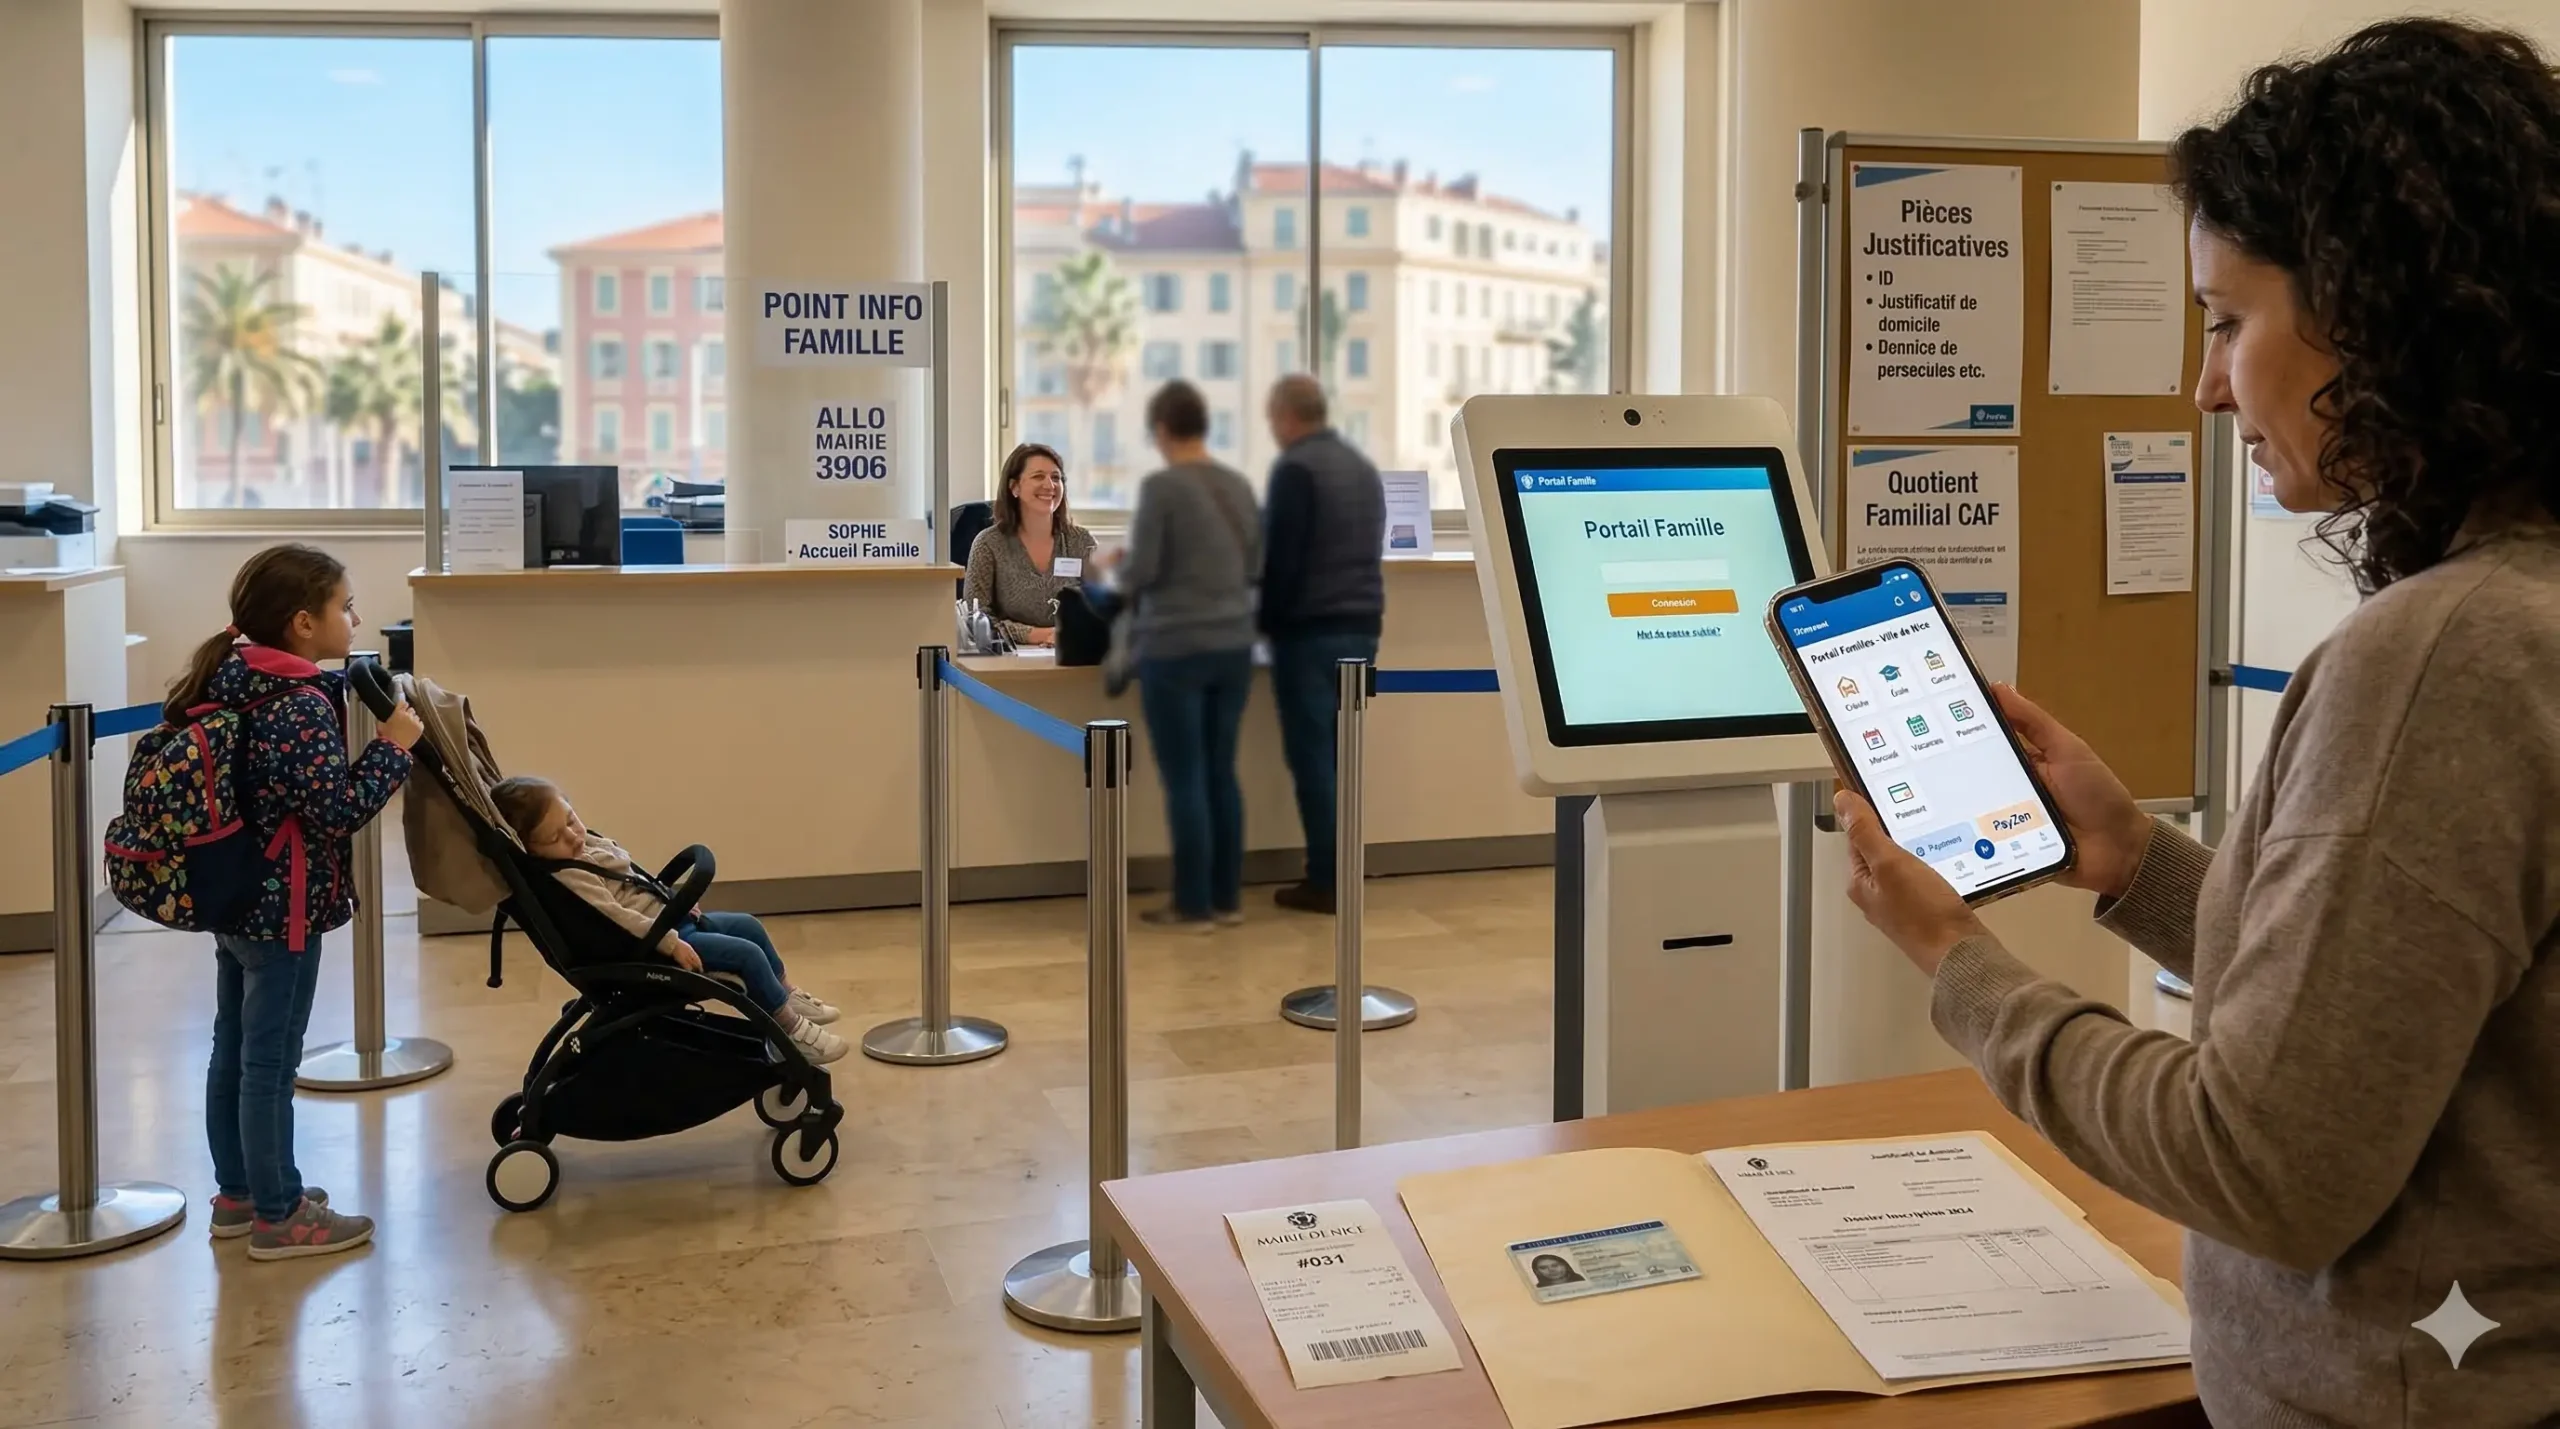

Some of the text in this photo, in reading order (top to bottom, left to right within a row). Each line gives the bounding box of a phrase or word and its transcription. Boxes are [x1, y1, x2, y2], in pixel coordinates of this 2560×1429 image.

[1901, 199, 1972, 224] Pièces
[1863, 233, 2009, 258] Justificatives
[1878, 270, 1894, 286] ID
[764, 292, 922, 320] POINT INFO
[1878, 294, 1977, 310] Justificatif de
[1878, 316, 1940, 332] domicile
[784, 328, 904, 355] FAMILLE
[1940, 340, 1958, 355] de
[1959, 364, 1985, 378] etc.
[816, 407, 885, 429] ALLO
[816, 434, 887, 450] MAIRIE
[816, 455, 887, 479] 3906
[1538, 476, 1566, 486] Portail
[1888, 470, 1979, 495] Quotient
[1866, 503, 2000, 526] Familial CAF
[828, 524, 886, 539] SOPHIE
[1584, 517, 1725, 539] Portail Famille
[799, 542, 919, 559] Accueil Famille
[1879, 632, 1899, 642] Ville
[1900, 628, 1910, 637] de
[1911, 621, 1931, 633] Nice
[1330, 1226, 1366, 1236] NICE
[1296, 1254, 1344, 1269] #031
